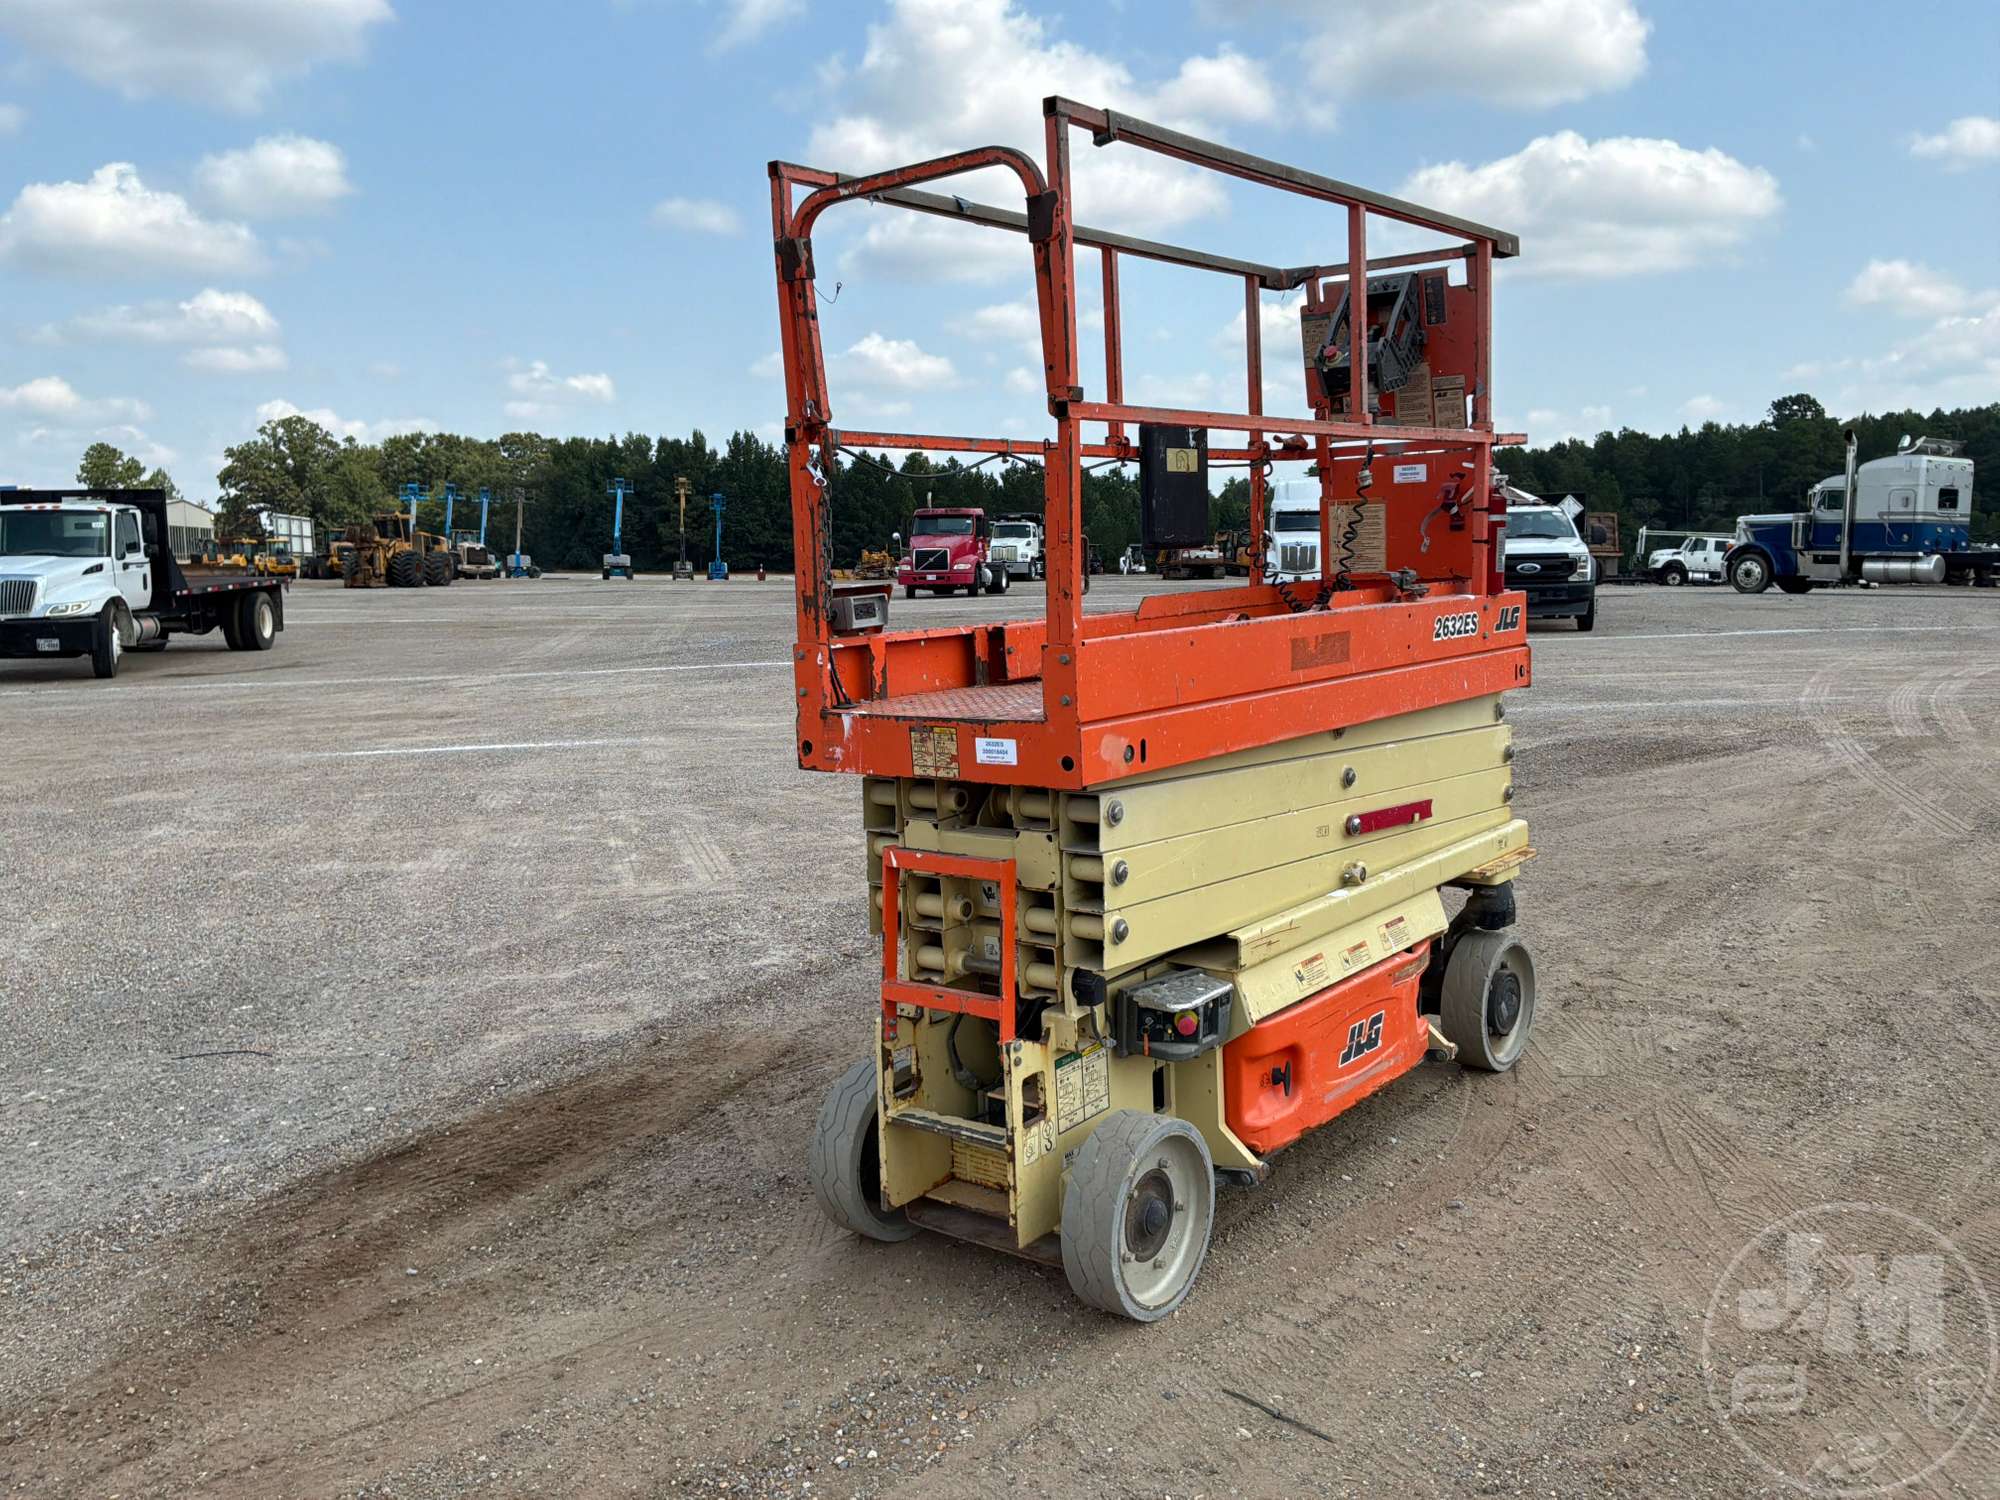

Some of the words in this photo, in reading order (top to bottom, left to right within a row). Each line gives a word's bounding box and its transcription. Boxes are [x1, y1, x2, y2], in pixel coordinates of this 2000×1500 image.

[1433, 612, 1479, 641] 2632ES
[1494, 605, 1521, 633] JLG
[1339, 1010, 1385, 1068] JLG
